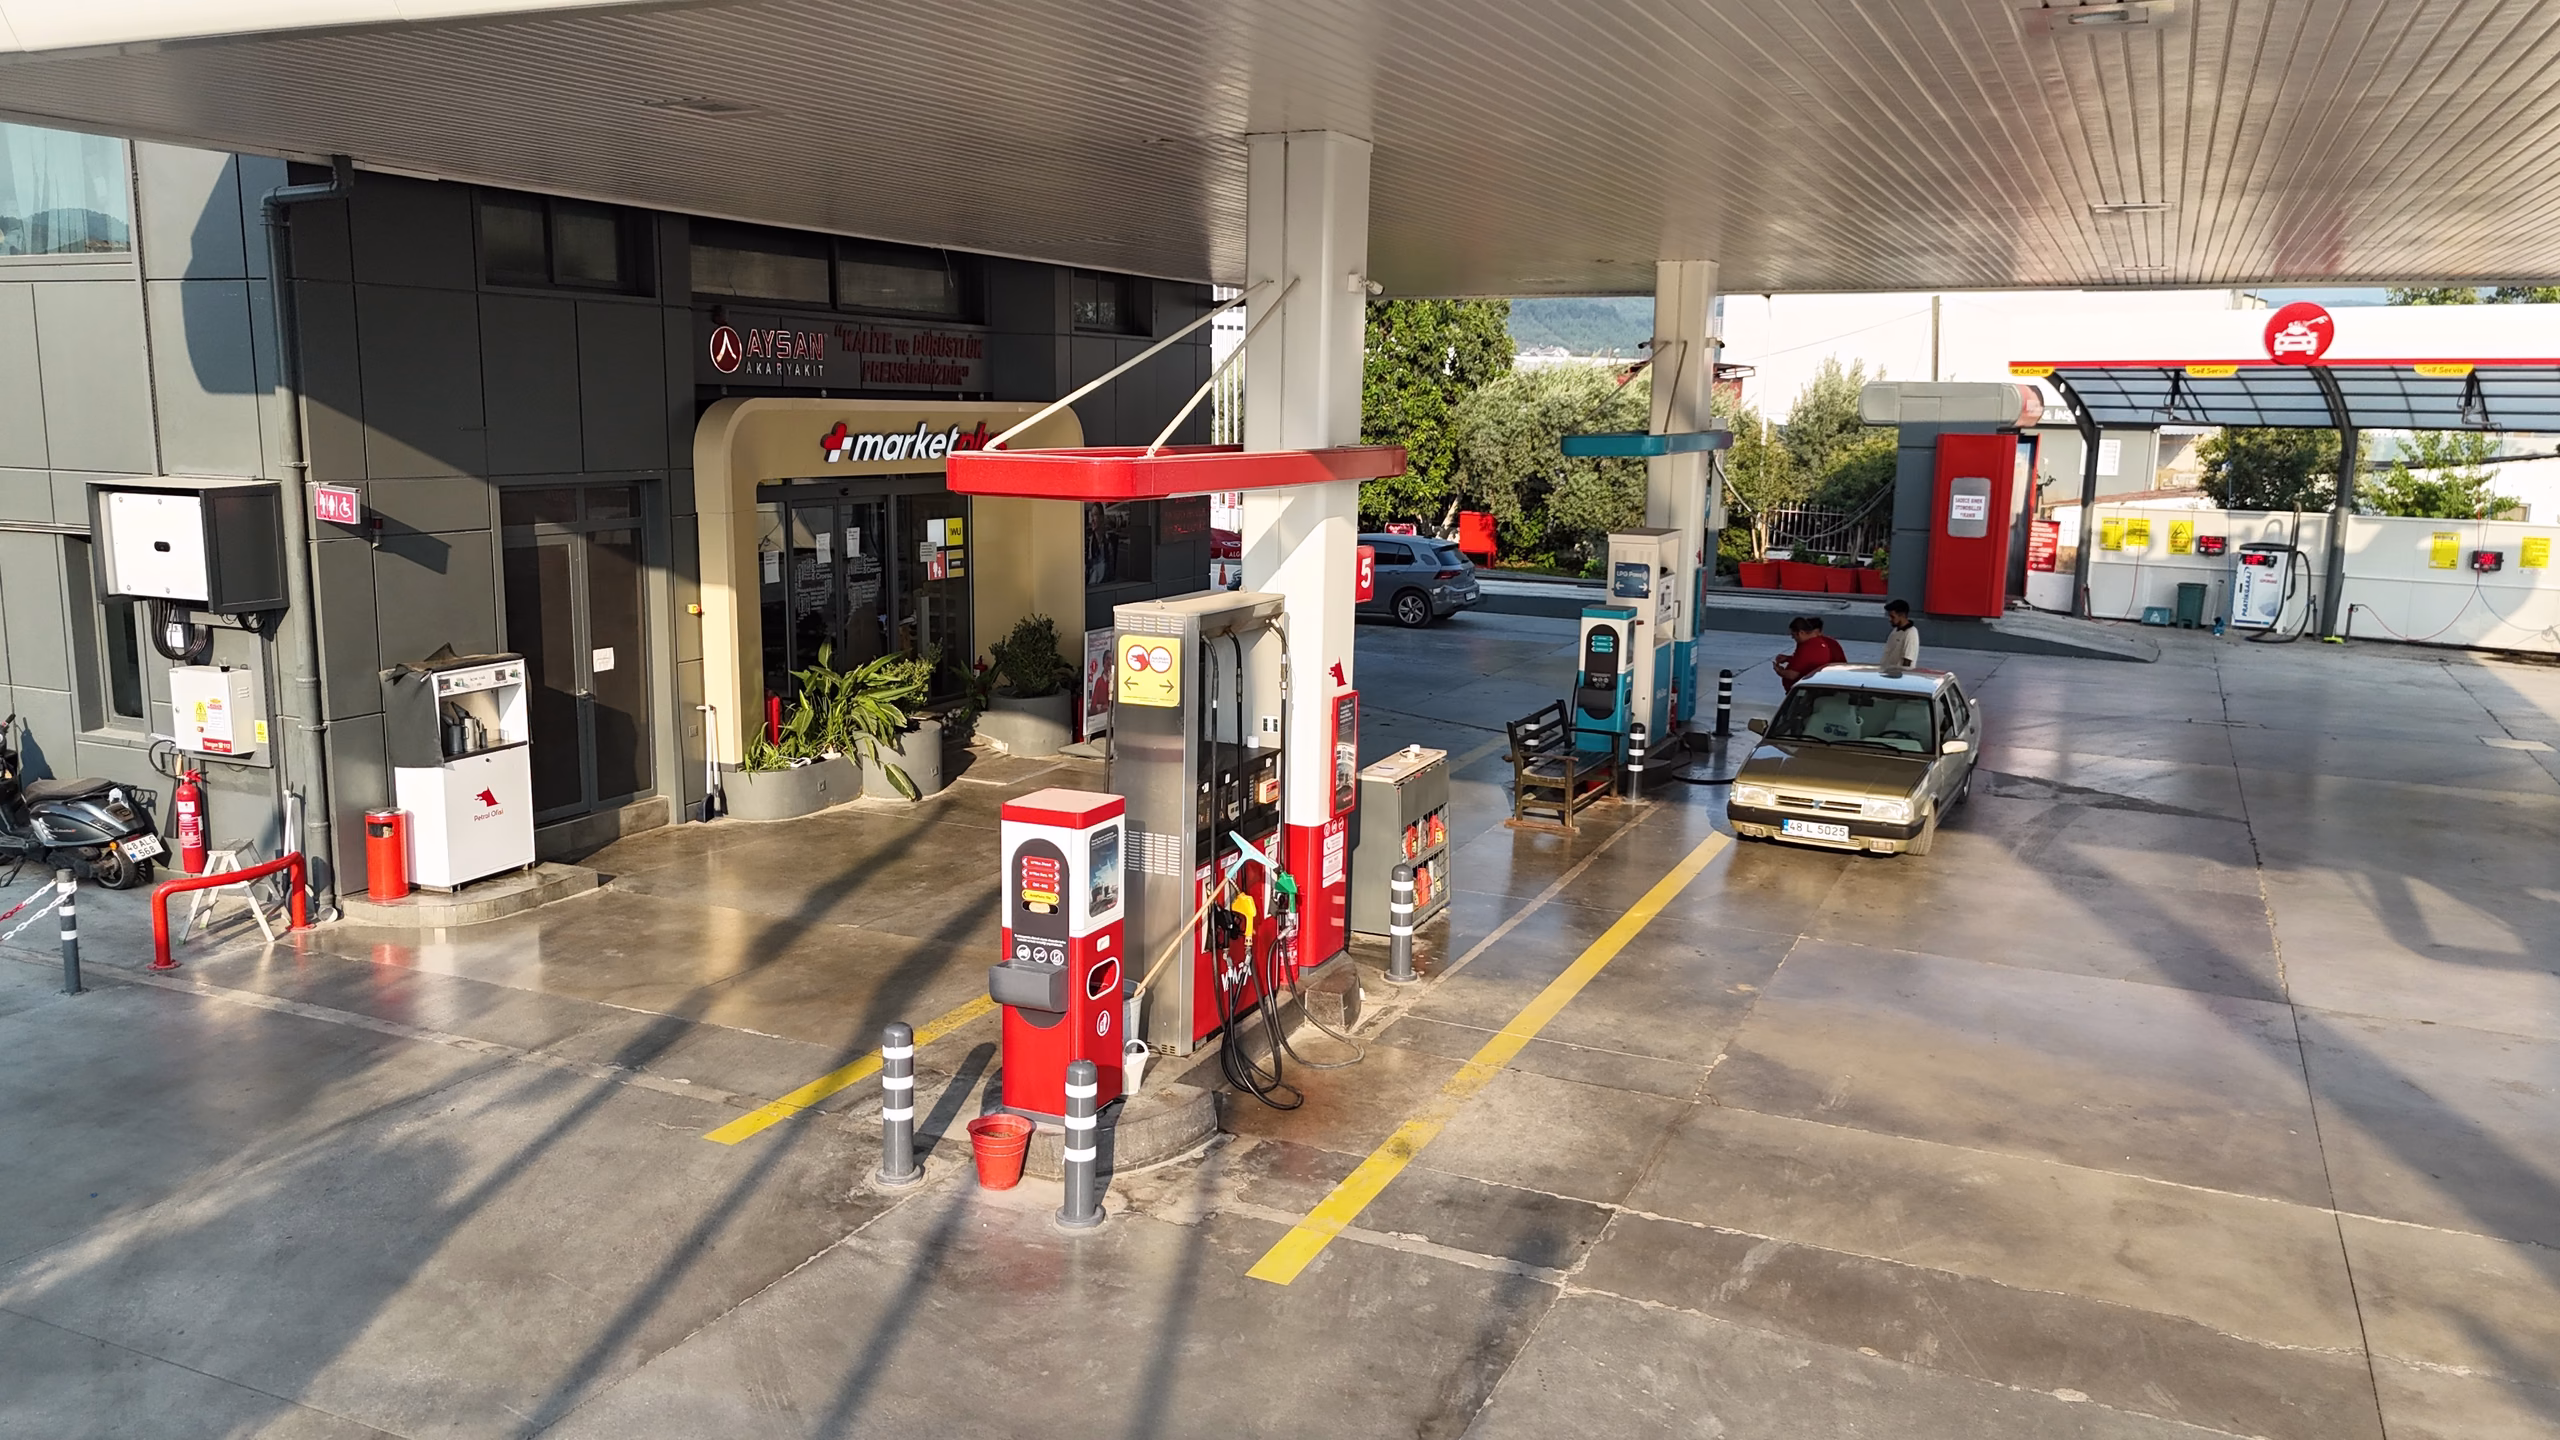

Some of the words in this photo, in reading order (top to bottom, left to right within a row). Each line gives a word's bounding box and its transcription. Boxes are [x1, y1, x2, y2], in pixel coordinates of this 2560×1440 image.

[746, 328, 824, 361] AYSAN
[895, 338, 910, 356] ve
[746, 361, 824, 377] AKARYAKIT
[1360, 556, 1372, 589] 5
[474, 811, 491, 822] Petrol
[491, 808, 504, 818] Ofisi
[1789, 822, 1803, 832] 48
[1806, 824, 1813, 833] L
[1817, 824, 1846, 837] 5025
[126, 842, 137, 852] 48
[140, 835, 157, 849] ALG
[138, 846, 156, 858] 568
